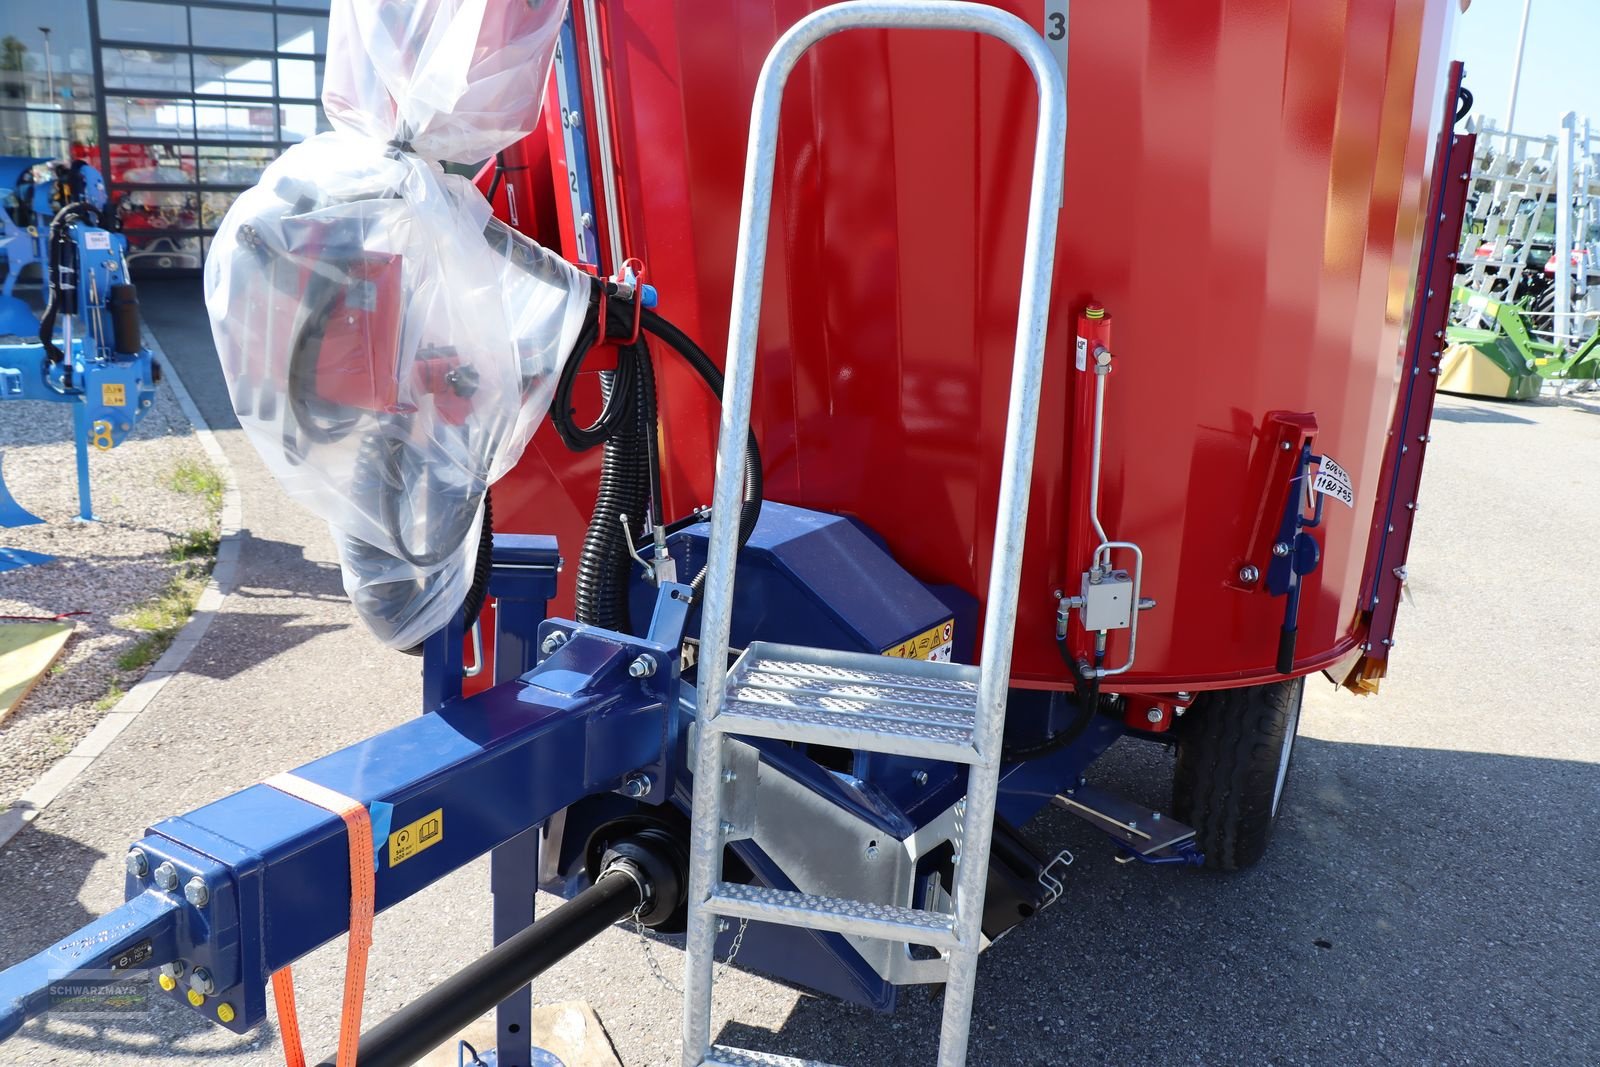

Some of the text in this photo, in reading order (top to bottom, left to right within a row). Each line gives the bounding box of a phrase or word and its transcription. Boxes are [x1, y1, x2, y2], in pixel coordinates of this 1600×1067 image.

[1048, 12, 1065, 40] 3
[555, 41, 562, 64] 4
[562, 107, 570, 129] 3
[570, 172, 577, 192] 2
[578, 233, 584, 254] 1
